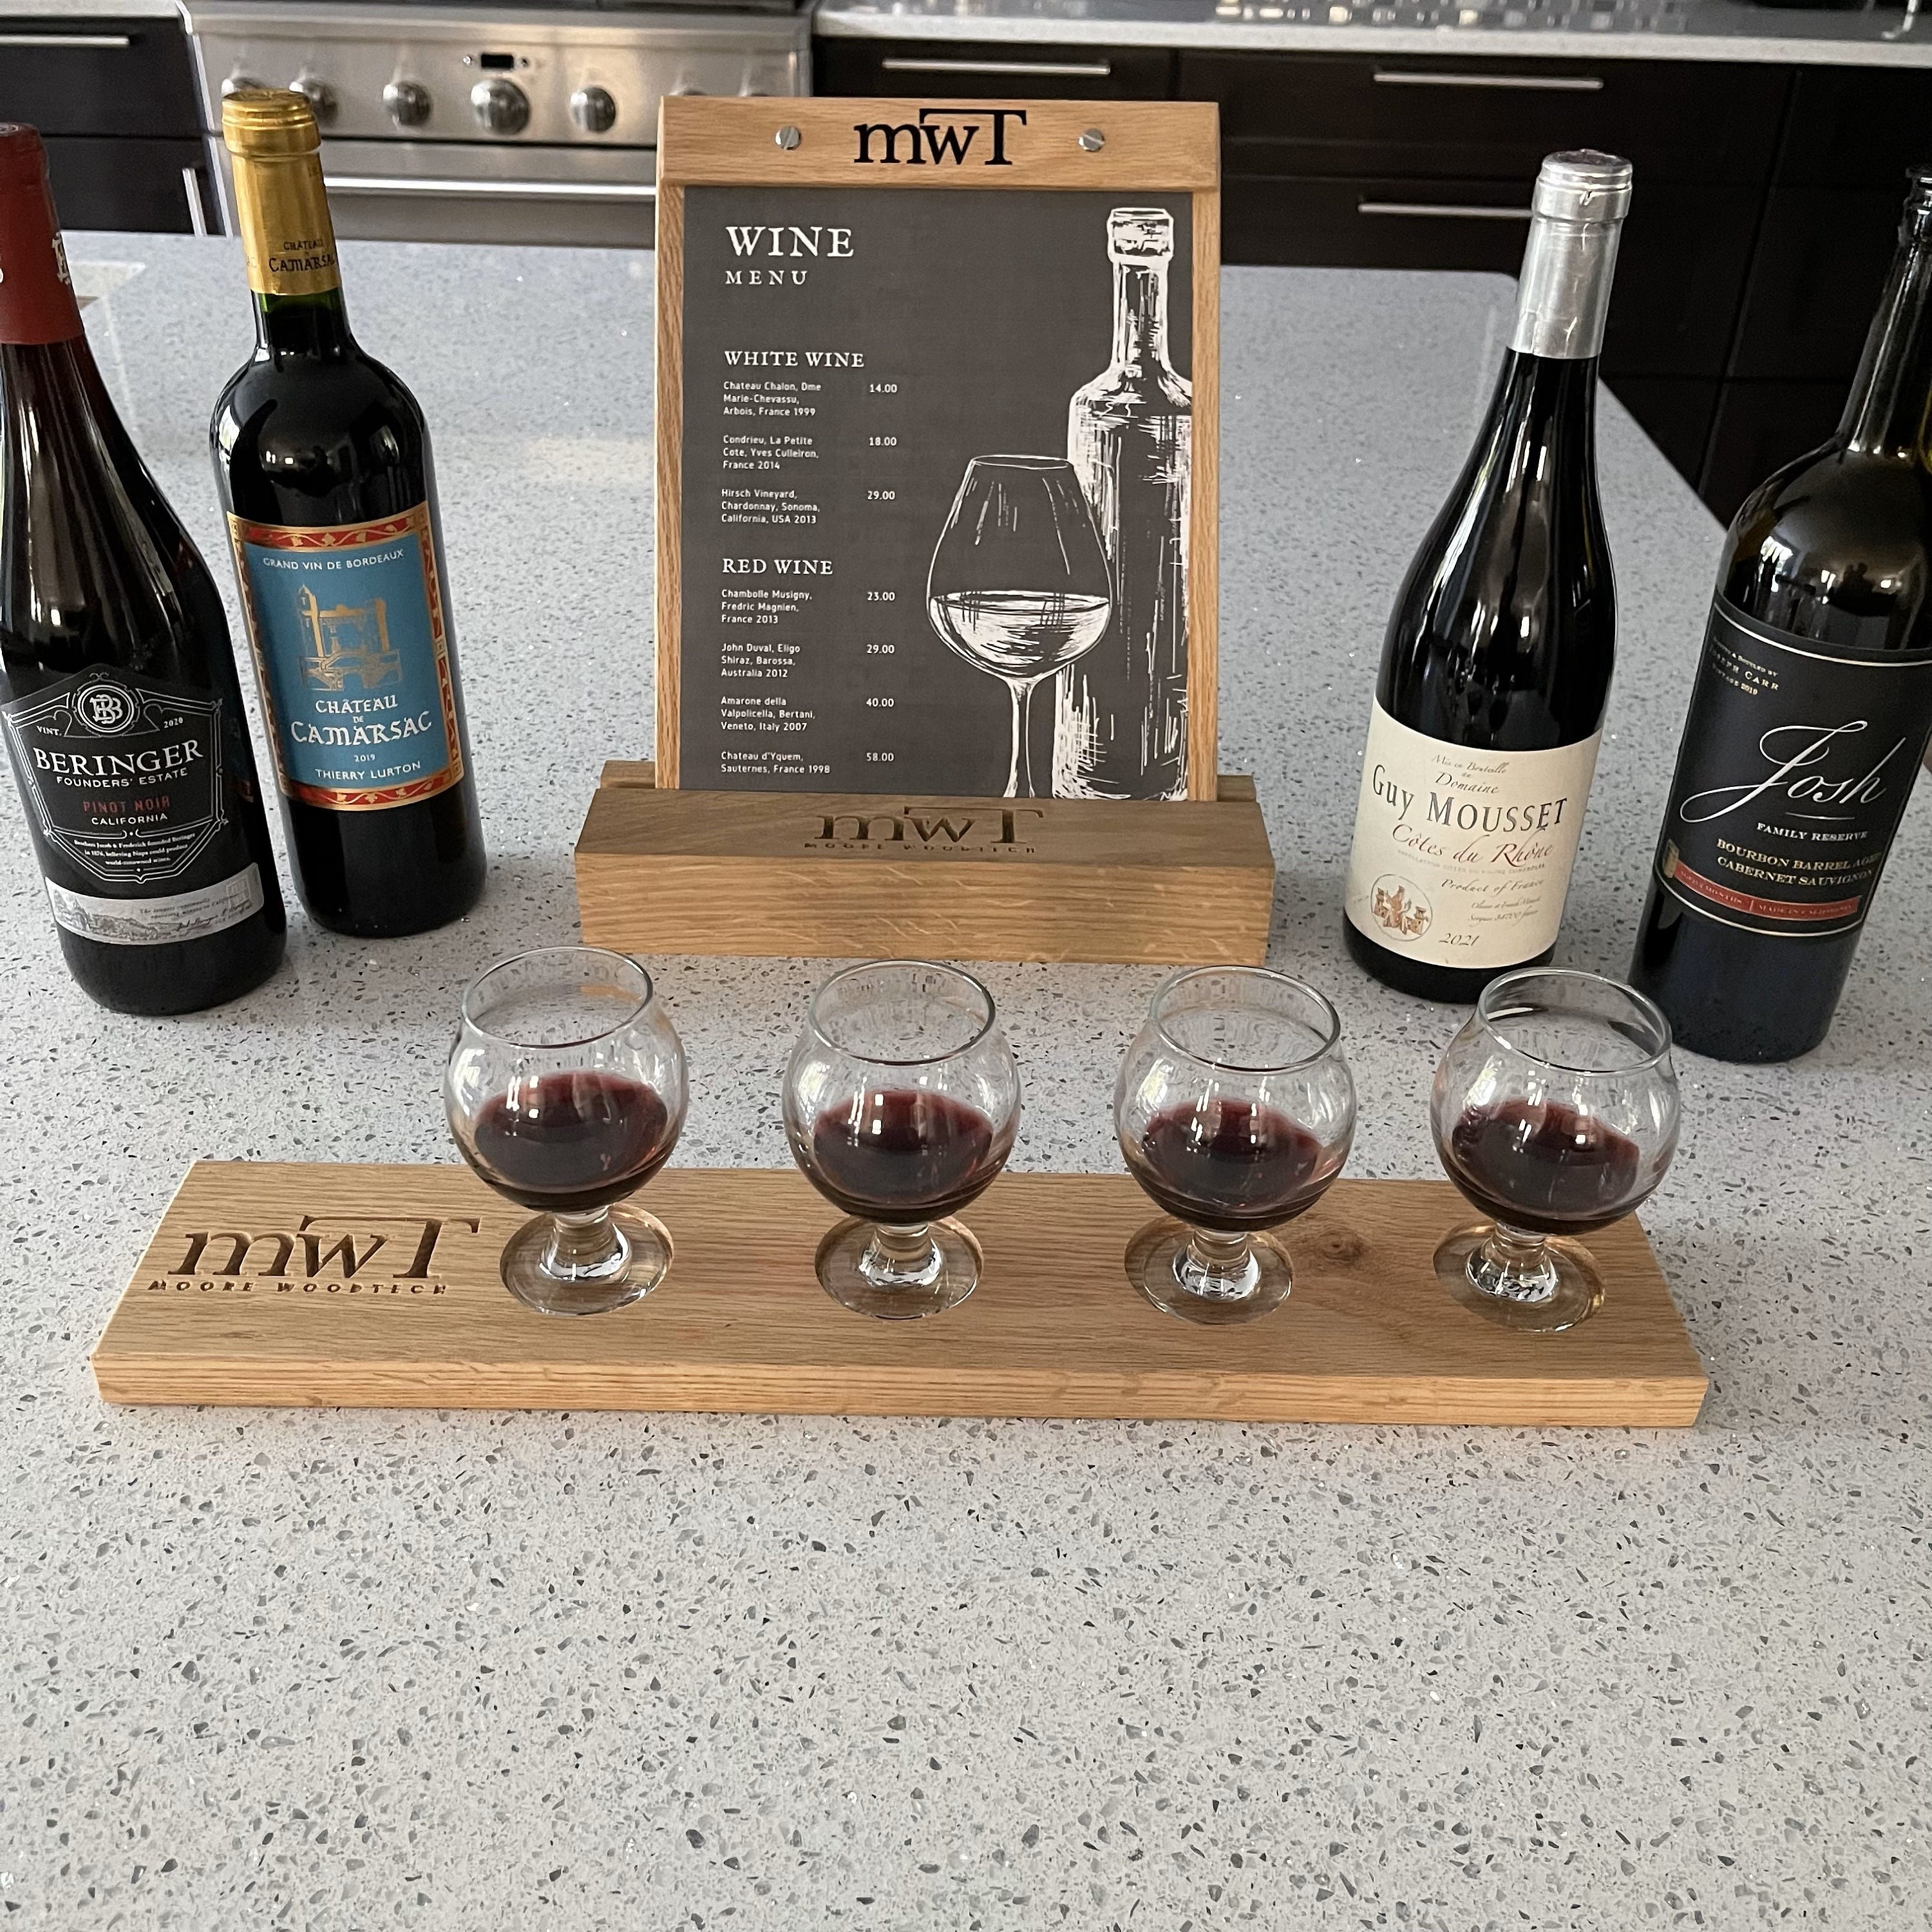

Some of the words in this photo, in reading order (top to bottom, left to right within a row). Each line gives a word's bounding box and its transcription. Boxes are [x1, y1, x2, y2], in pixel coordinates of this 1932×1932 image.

[726, 226, 854, 258] WINE
[725, 270, 808, 285] MENU
[724, 351, 798, 366] WHITE
[805, 352, 864, 367] WINE
[723, 381, 761, 390] Chateau
[764, 382, 798, 392] Chalon,
[801, 383, 821, 391] Dme
[869, 384, 897, 393] 14.00
[723, 393, 799, 404] Marie-Chevassu,
[723, 407, 755, 417] Arbois,
[759, 407, 790, 416] France
[794, 408, 816, 416] 1999
[723, 435, 766, 445] Condrieu,
[770, 436, 781, 444] La
[784, 436, 813, 445] Petite
[869, 437, 897, 446] 18.00
[723, 448, 748, 457] Cote,
[750, 448, 772, 457] Yves
[723, 460, 755, 469] France
[757, 461, 780, 469] 2014
[721, 489, 751, 498] Hirsch
[754, 489, 798, 499] Vineyard,
[867, 491, 896, 500] 29.00
[721, 501, 779, 512] Chardonnay,
[781, 502, 820, 512] Sonoma,
[721, 514, 769, 524] California,
[772, 515, 791, 524] USA
[794, 515, 817, 524] 2013
[263, 557, 299, 570] GRAND
[327, 561, 343, 570] DE
[346, 549, 404, 569] BORDEAUX
[722, 558, 767, 574] RED
[774, 560, 833, 574] WINE
[721, 589, 769, 599] Chambolle
[772, 590, 813, 601] Musigny,
[867, 592, 895, 601] 23.00
[721, 601, 755, 611] Fredric
[757, 603, 799, 613] Magnien,
[721, 614, 753, 623] France
[756, 615, 779, 624] 2013
[721, 643, 743, 652] John
[746, 644, 774, 654] Duval,
[777, 645, 800, 655] Eligo
[867, 644, 895, 654] 29.00
[721, 656, 753, 665] Shiraz,
[756, 656, 796, 666] Barossa,
[721, 668, 762, 677] Australia
[766, 668, 788, 677] 2012
[1745, 671, 1779, 691] CARR
[315, 694, 398, 714] CHÂTEAU
[721, 696, 761, 705] Amarone
[764, 697, 787, 706] della
[866, 697, 895, 707] 40.00
[721, 708, 776, 719] Valpolicella,
[779, 710, 816, 719] Bertani,
[164, 717, 184, 728] 2020
[721, 722, 757, 732] Veneto,
[759, 722, 780, 732] Italy
[783, 723, 808, 731] 2007
[36, 725, 62, 736] VINT.
[291, 711, 432, 746] CAMARSAC
[33, 739, 204, 776] BERINGER
[354, 753, 375, 762] 2019
[721, 752, 759, 761] Chateau
[761, 752, 804, 762] d'Yquem,
[866, 752, 895, 762] 58.00
[314, 768, 365, 781] THIERRY
[370, 761, 421, 779] LURTON
[721, 764, 770, 774] Sauternes,
[773, 764, 805, 773] France
[808, 765, 831, 773] 1998
[1680, 720, 1906, 823] Josh
[56, 776, 133, 788] FOUNDERS'
[139, 767, 188, 785] ESTATE
[1435, 772, 1499, 793] Domaine
[1373, 764, 1414, 820] Guy
[1426, 791, 1567, 832] MOUSSET
[83, 800, 126, 813] PINOT
[134, 796, 169, 811] NOIR
[91, 813, 167, 825] CALIFORNIA
[1757, 822, 1808, 840] FAMILY
[1811, 831, 1868, 841] RESERVE
[1392, 824, 1445, 856] Côtes
[1453, 835, 1490, 863] du
[1490, 829, 1553, 867] Rhône
[1716, 838, 1790, 867] BOURBON
[1792, 860, 1850, 870] BARREL
[1718, 857, 1797, 884] CABERNET
[1439, 933, 1481, 946] 2021
[147, 1280, 254, 1292] MOORE
[276, 1282, 447, 1295] WOODTECH
